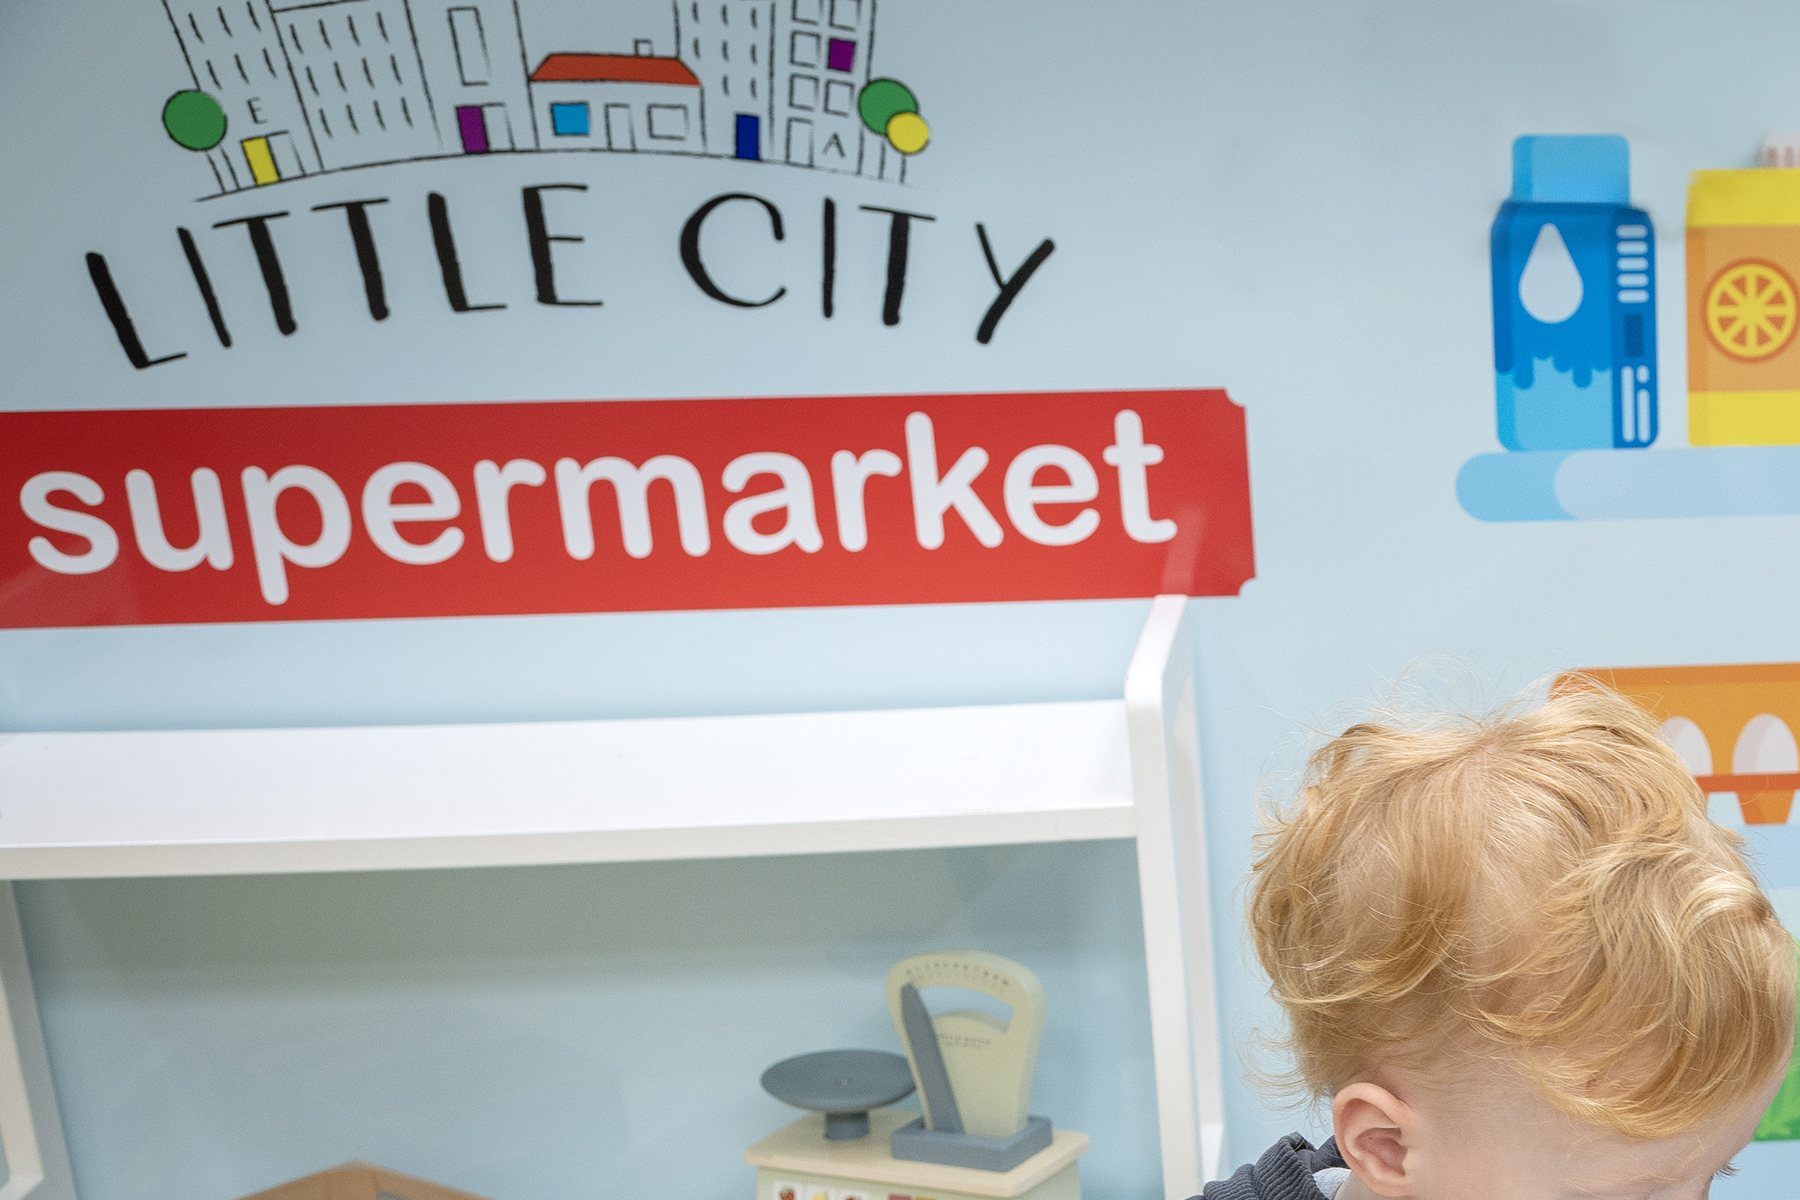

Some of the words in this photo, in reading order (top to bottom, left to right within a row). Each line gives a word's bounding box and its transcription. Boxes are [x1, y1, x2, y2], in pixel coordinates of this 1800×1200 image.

[85, 184, 604, 369] LITTLE
[680, 192, 1056, 345] CITY
[19, 408, 1178, 606] supermarket
